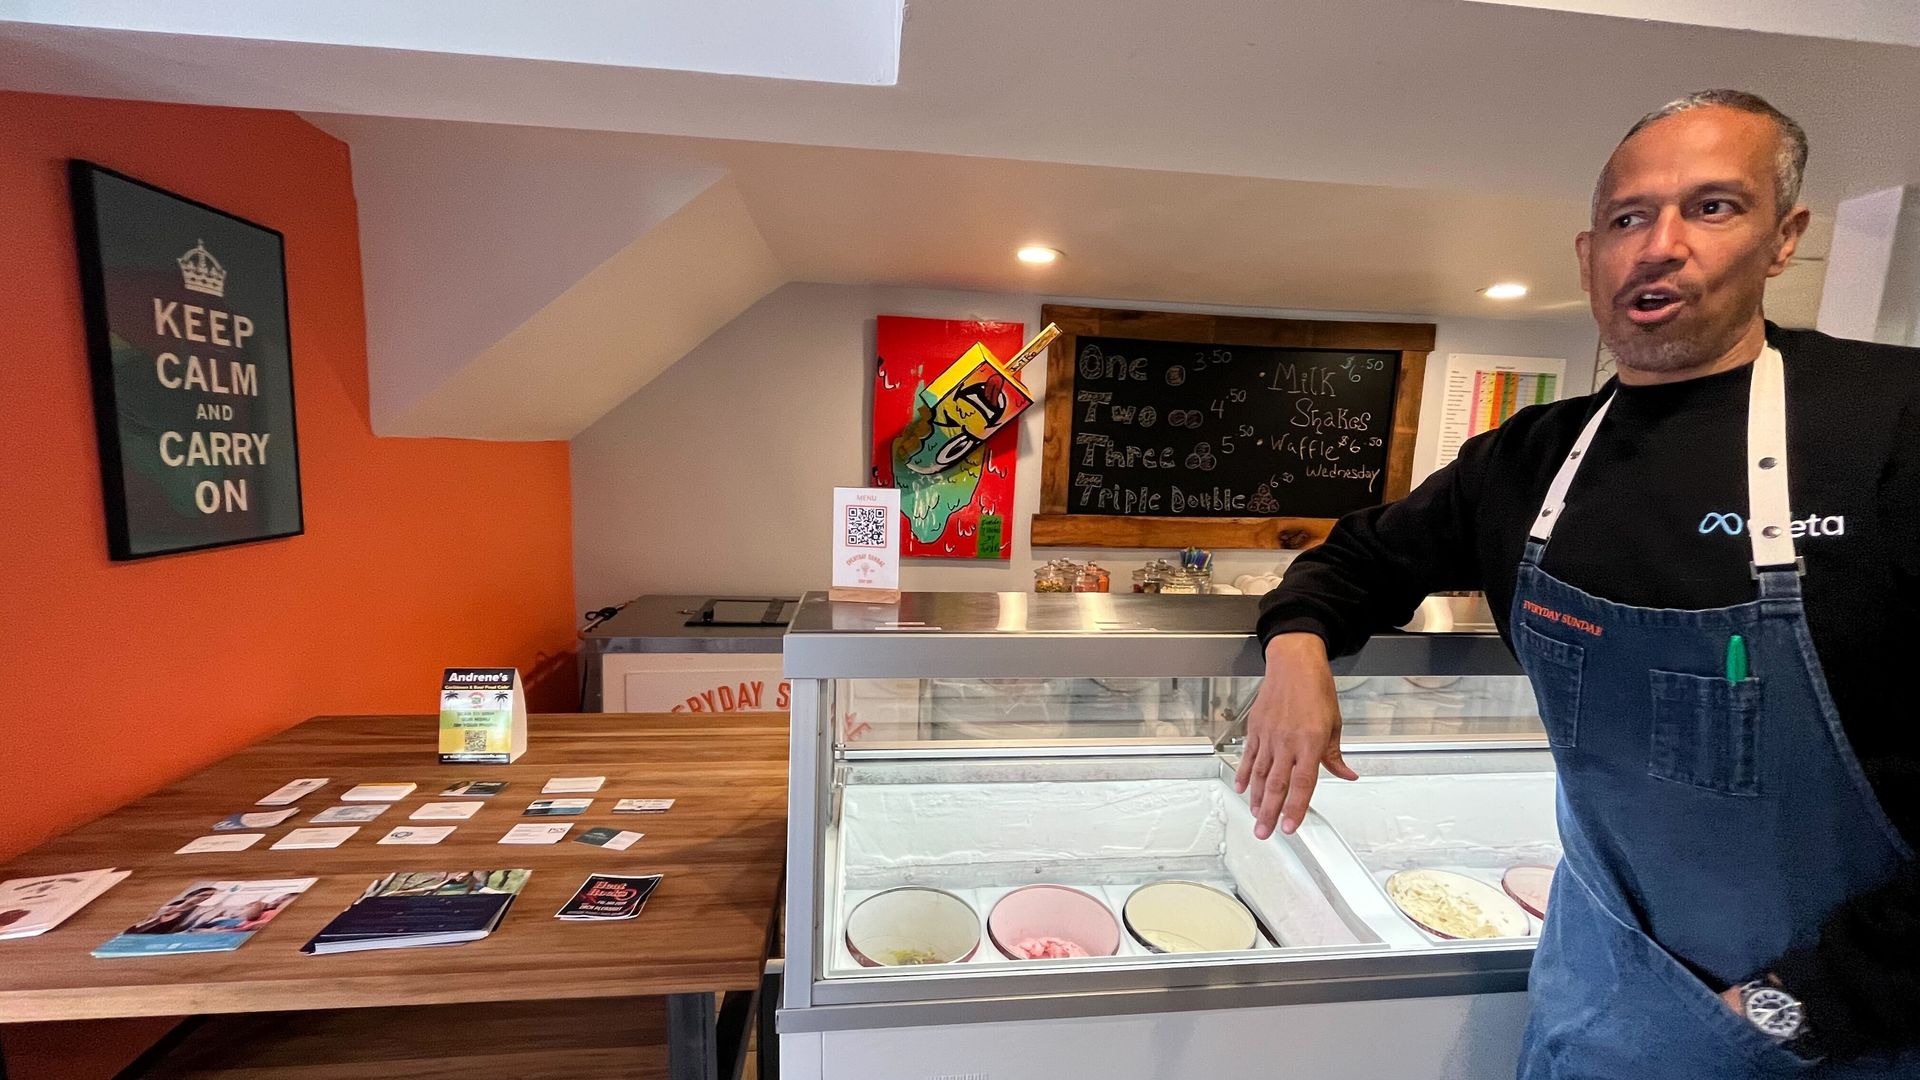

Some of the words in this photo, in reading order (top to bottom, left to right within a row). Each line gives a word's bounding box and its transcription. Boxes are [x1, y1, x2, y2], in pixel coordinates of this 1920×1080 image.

[153, 298, 254, 348] KEEP
[156, 352, 258, 396] CALM
[1079, 344, 1149, 381] One
[1267, 362, 1336, 397] Milk
[196, 403, 233, 421] AND
[1077, 390, 1157, 428] Two
[159, 431, 270, 467] CARRY
[1076, 433, 1176, 468] Three
[1270, 433, 1340, 460] Waffle
[1075, 472, 1162, 513] Triple
[1171, 485, 1246, 513] Double
[1306, 463, 1380, 493] Wednesday
[195, 479, 248, 514] ON
[1747, 513, 1845, 538] eta
[1523, 600, 1561, 621] EVERYDAY
[1561, 614, 1604, 636] SUNDAE
[448, 672, 508, 682] Andrene's
